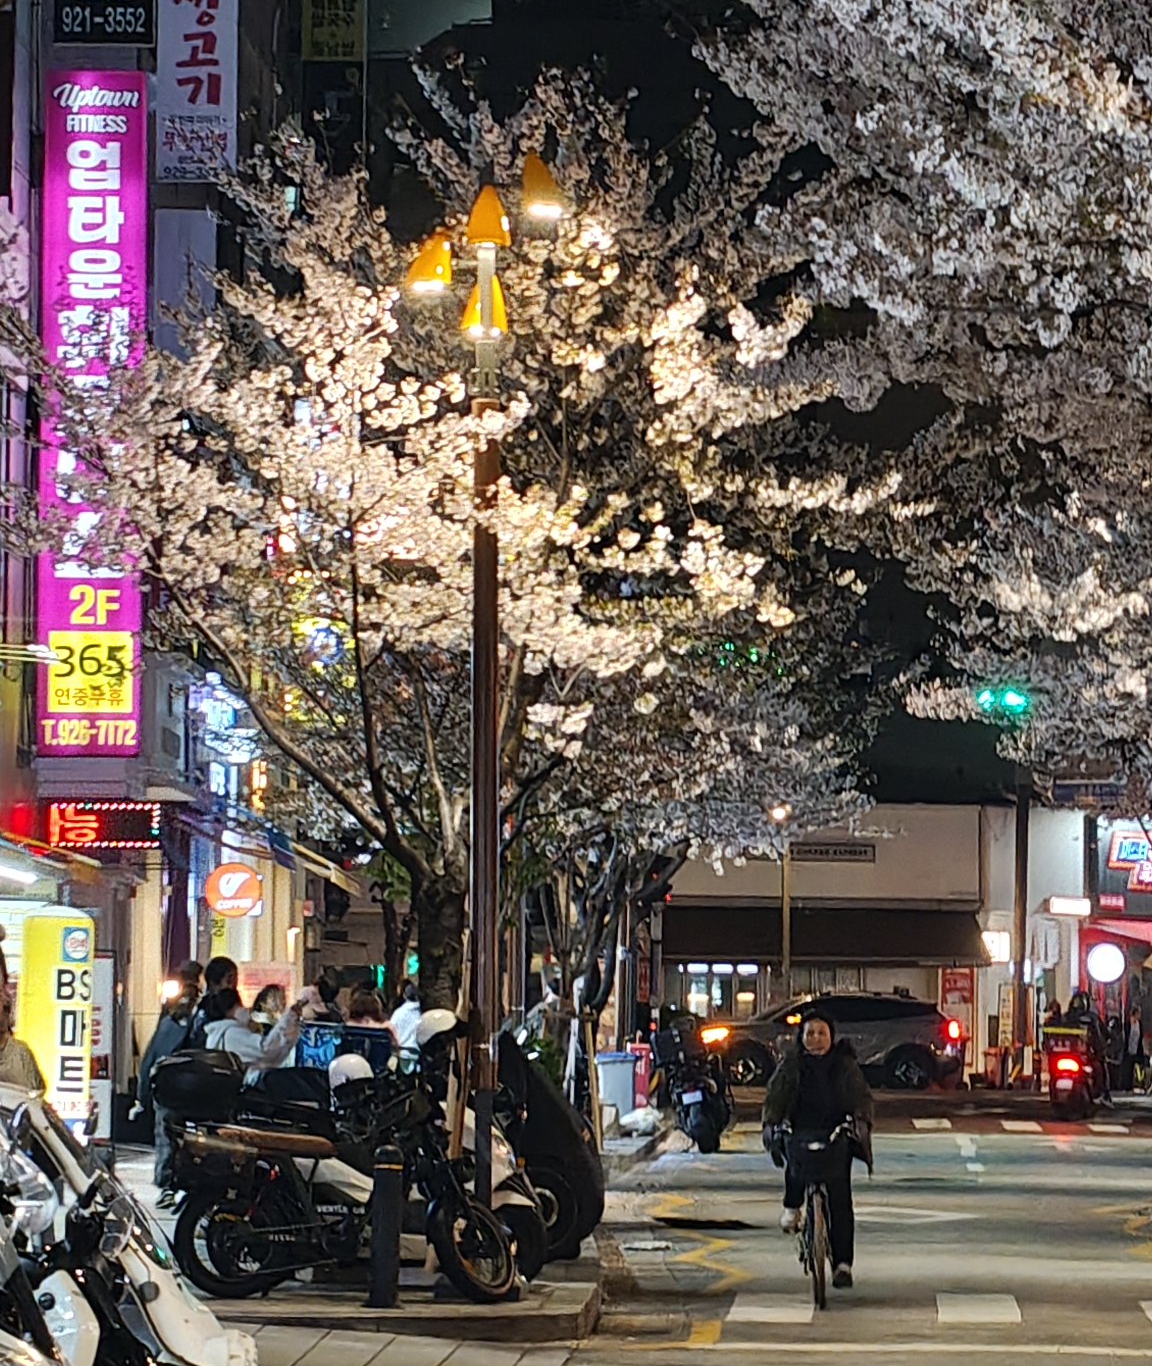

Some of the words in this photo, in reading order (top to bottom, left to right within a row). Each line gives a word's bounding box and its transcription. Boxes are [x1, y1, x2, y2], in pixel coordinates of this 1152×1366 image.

[62, 6, 146, 33] 921-3552
[53, 82, 140, 113] Uptown
[66, 114, 128, 134] FITNESS
[69, 584, 121, 626] 2F
[54, 643, 126, 678] 365
[54, 687, 124, 707] 연중무휴
[41, 718, 137, 746] T.926-7172
[56, 968, 92, 1002] BS
